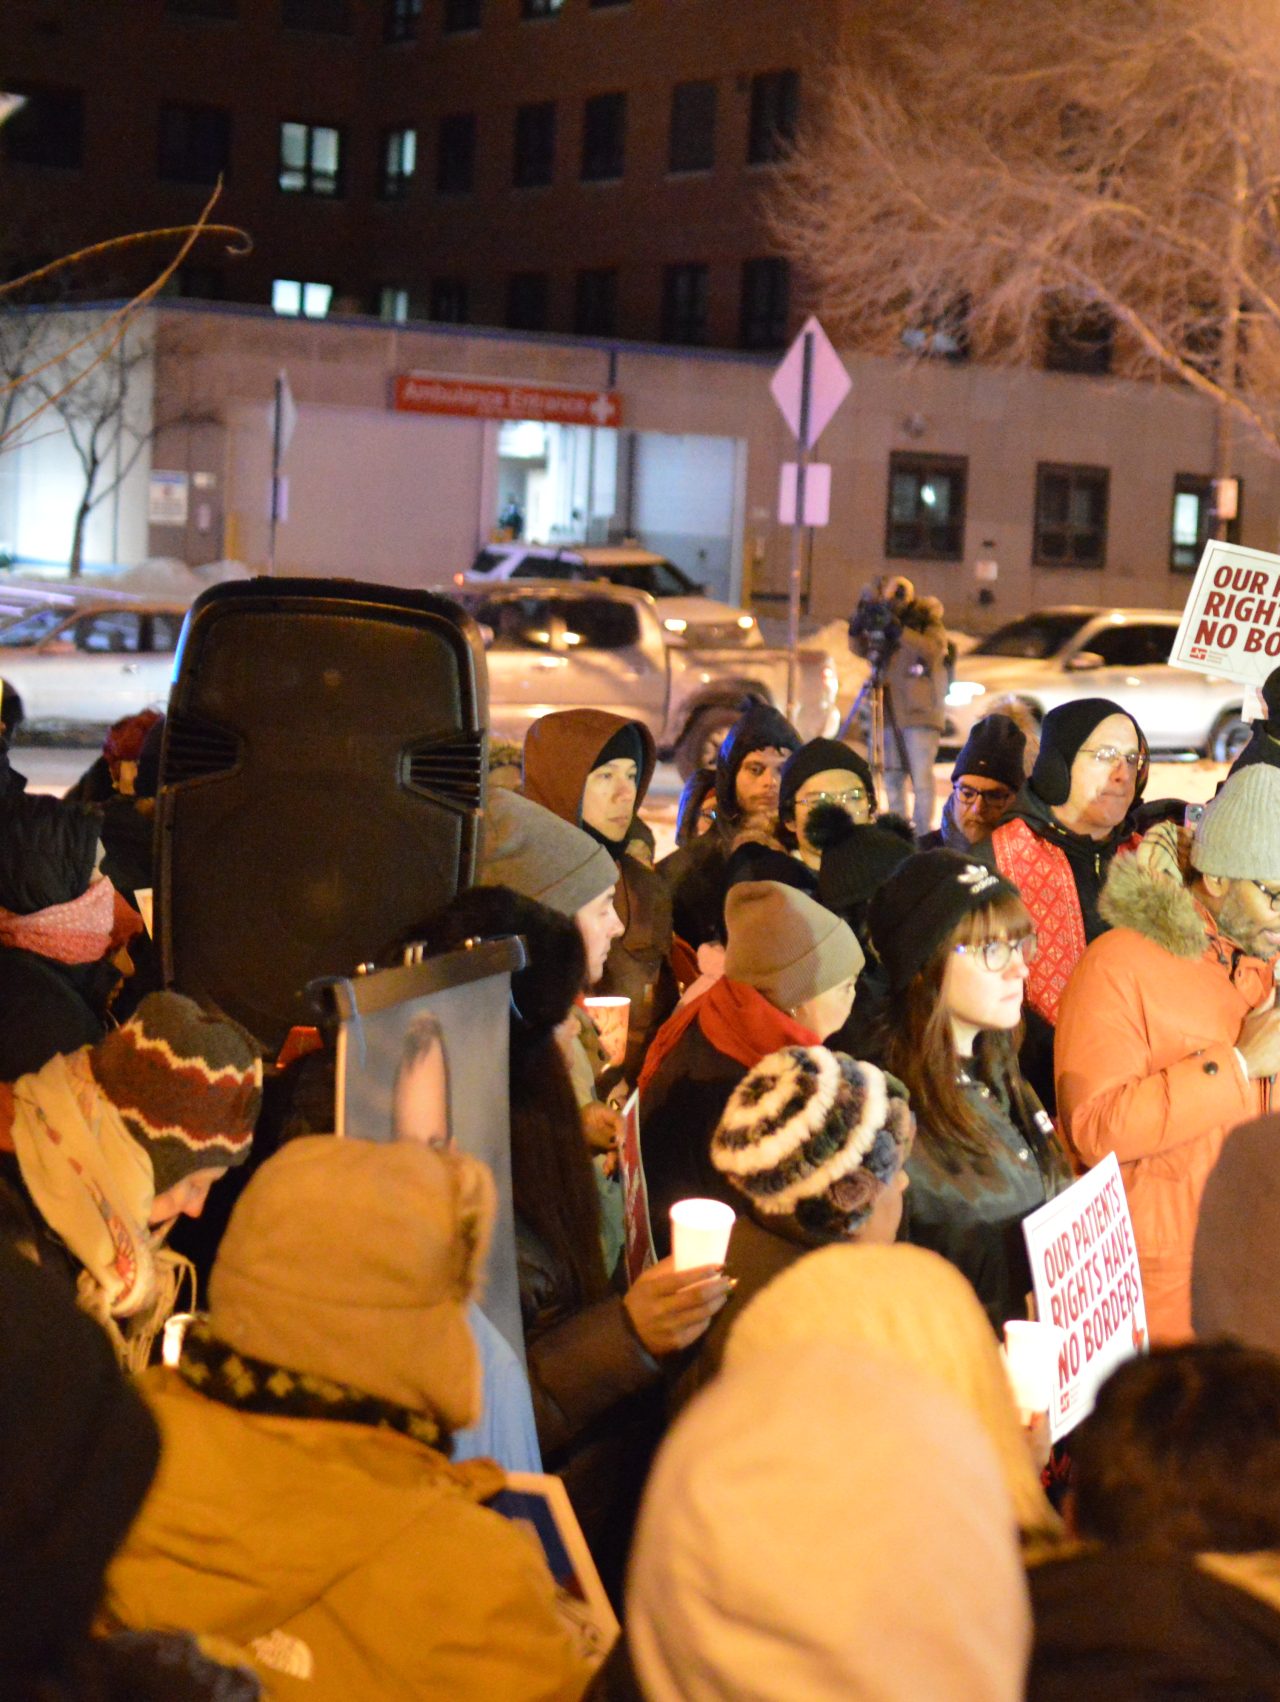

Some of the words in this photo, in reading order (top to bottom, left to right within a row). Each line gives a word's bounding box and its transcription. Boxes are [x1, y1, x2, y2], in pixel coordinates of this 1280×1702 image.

[404, 381, 505, 406] Ambulance
[509, 389, 588, 412] Entrance
[1213, 565, 1269, 596] OUR
[1194, 619, 1238, 649] NO
[1043, 1231, 1074, 1289] OUR
[1050, 1251, 1103, 1330] RIGHTS
[1101, 1215, 1132, 1284] HAVE
[1058, 1331, 1080, 1390] NO
[1082, 1261, 1139, 1363] BORDERS
